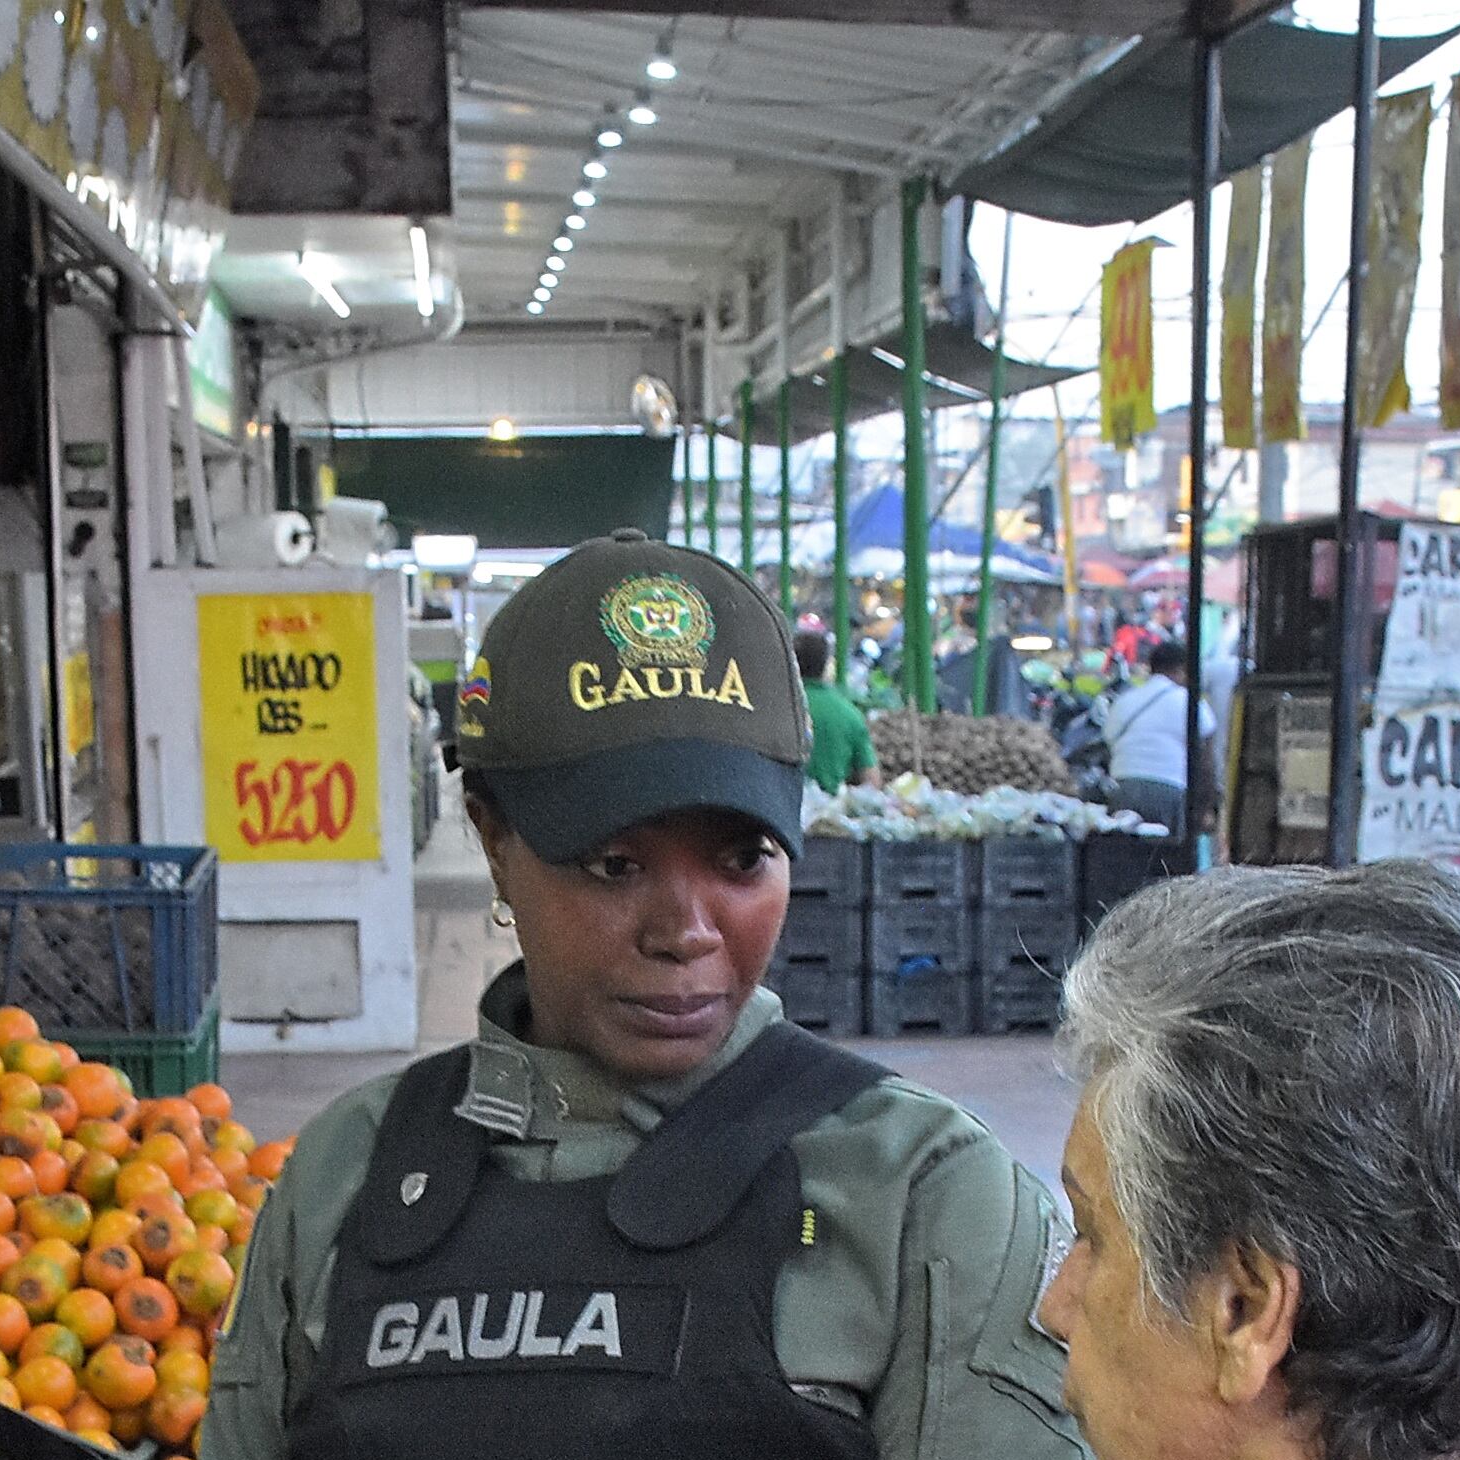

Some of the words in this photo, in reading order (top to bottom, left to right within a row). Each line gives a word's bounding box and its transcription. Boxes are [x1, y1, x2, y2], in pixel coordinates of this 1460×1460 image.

[568, 657, 754, 711] GAULA
[235, 758, 357, 846] 5250
[366, 1291, 623, 1369] GAULA
